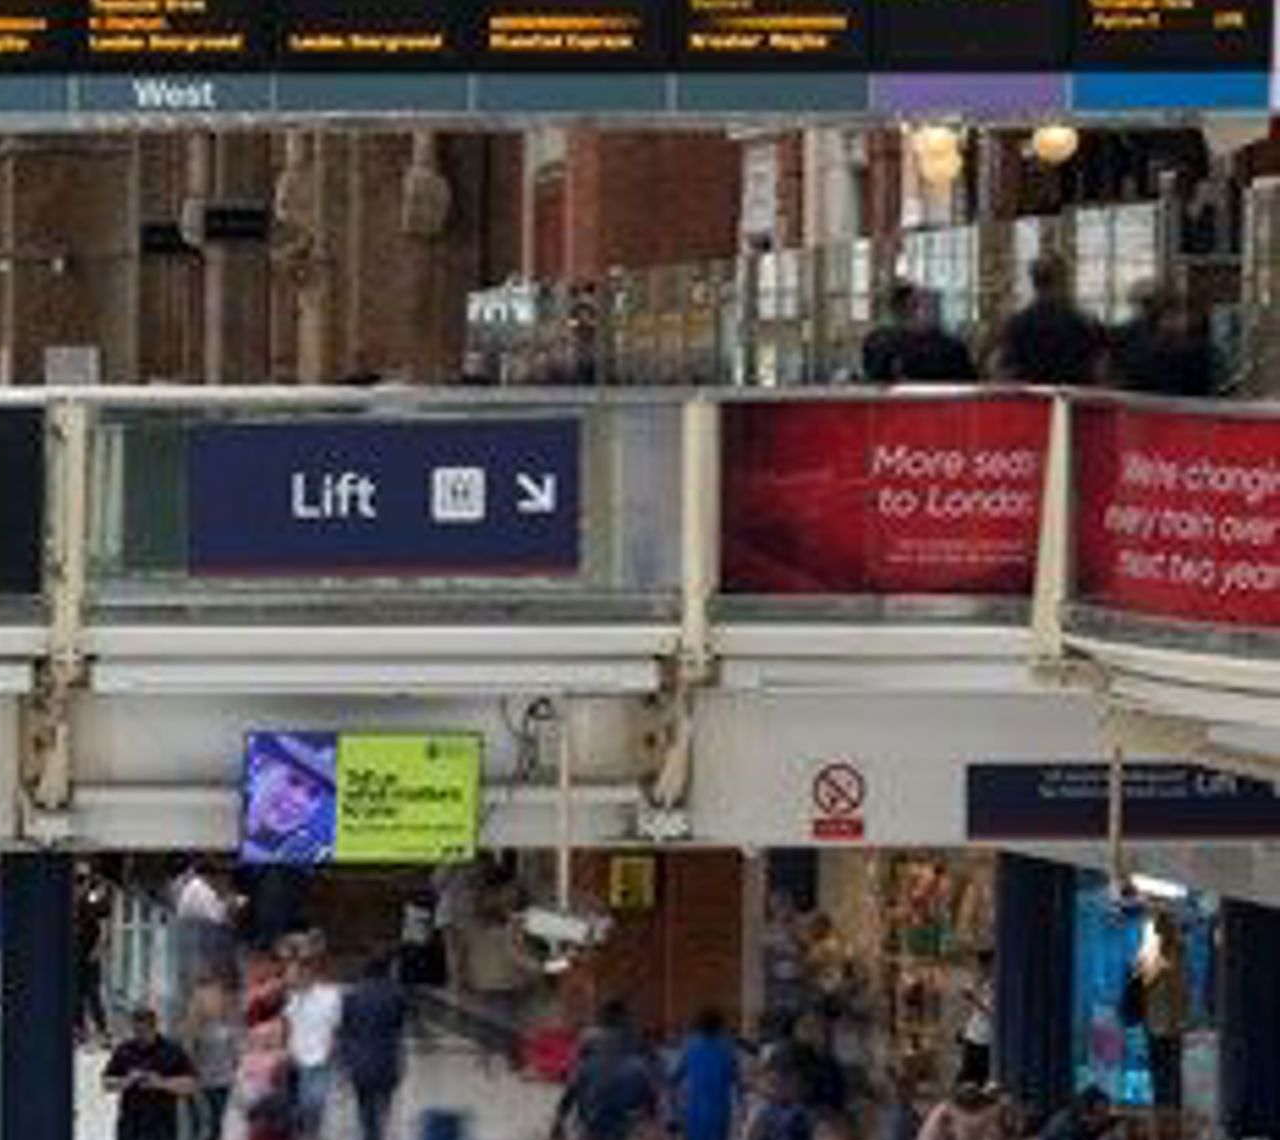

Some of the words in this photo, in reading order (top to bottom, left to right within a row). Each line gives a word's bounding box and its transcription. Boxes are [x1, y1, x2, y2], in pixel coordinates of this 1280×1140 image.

[134, 80, 214, 107] West
[871, 445, 964, 480] More
[292, 472, 377, 518] Lift
[878, 488, 920, 518] to
